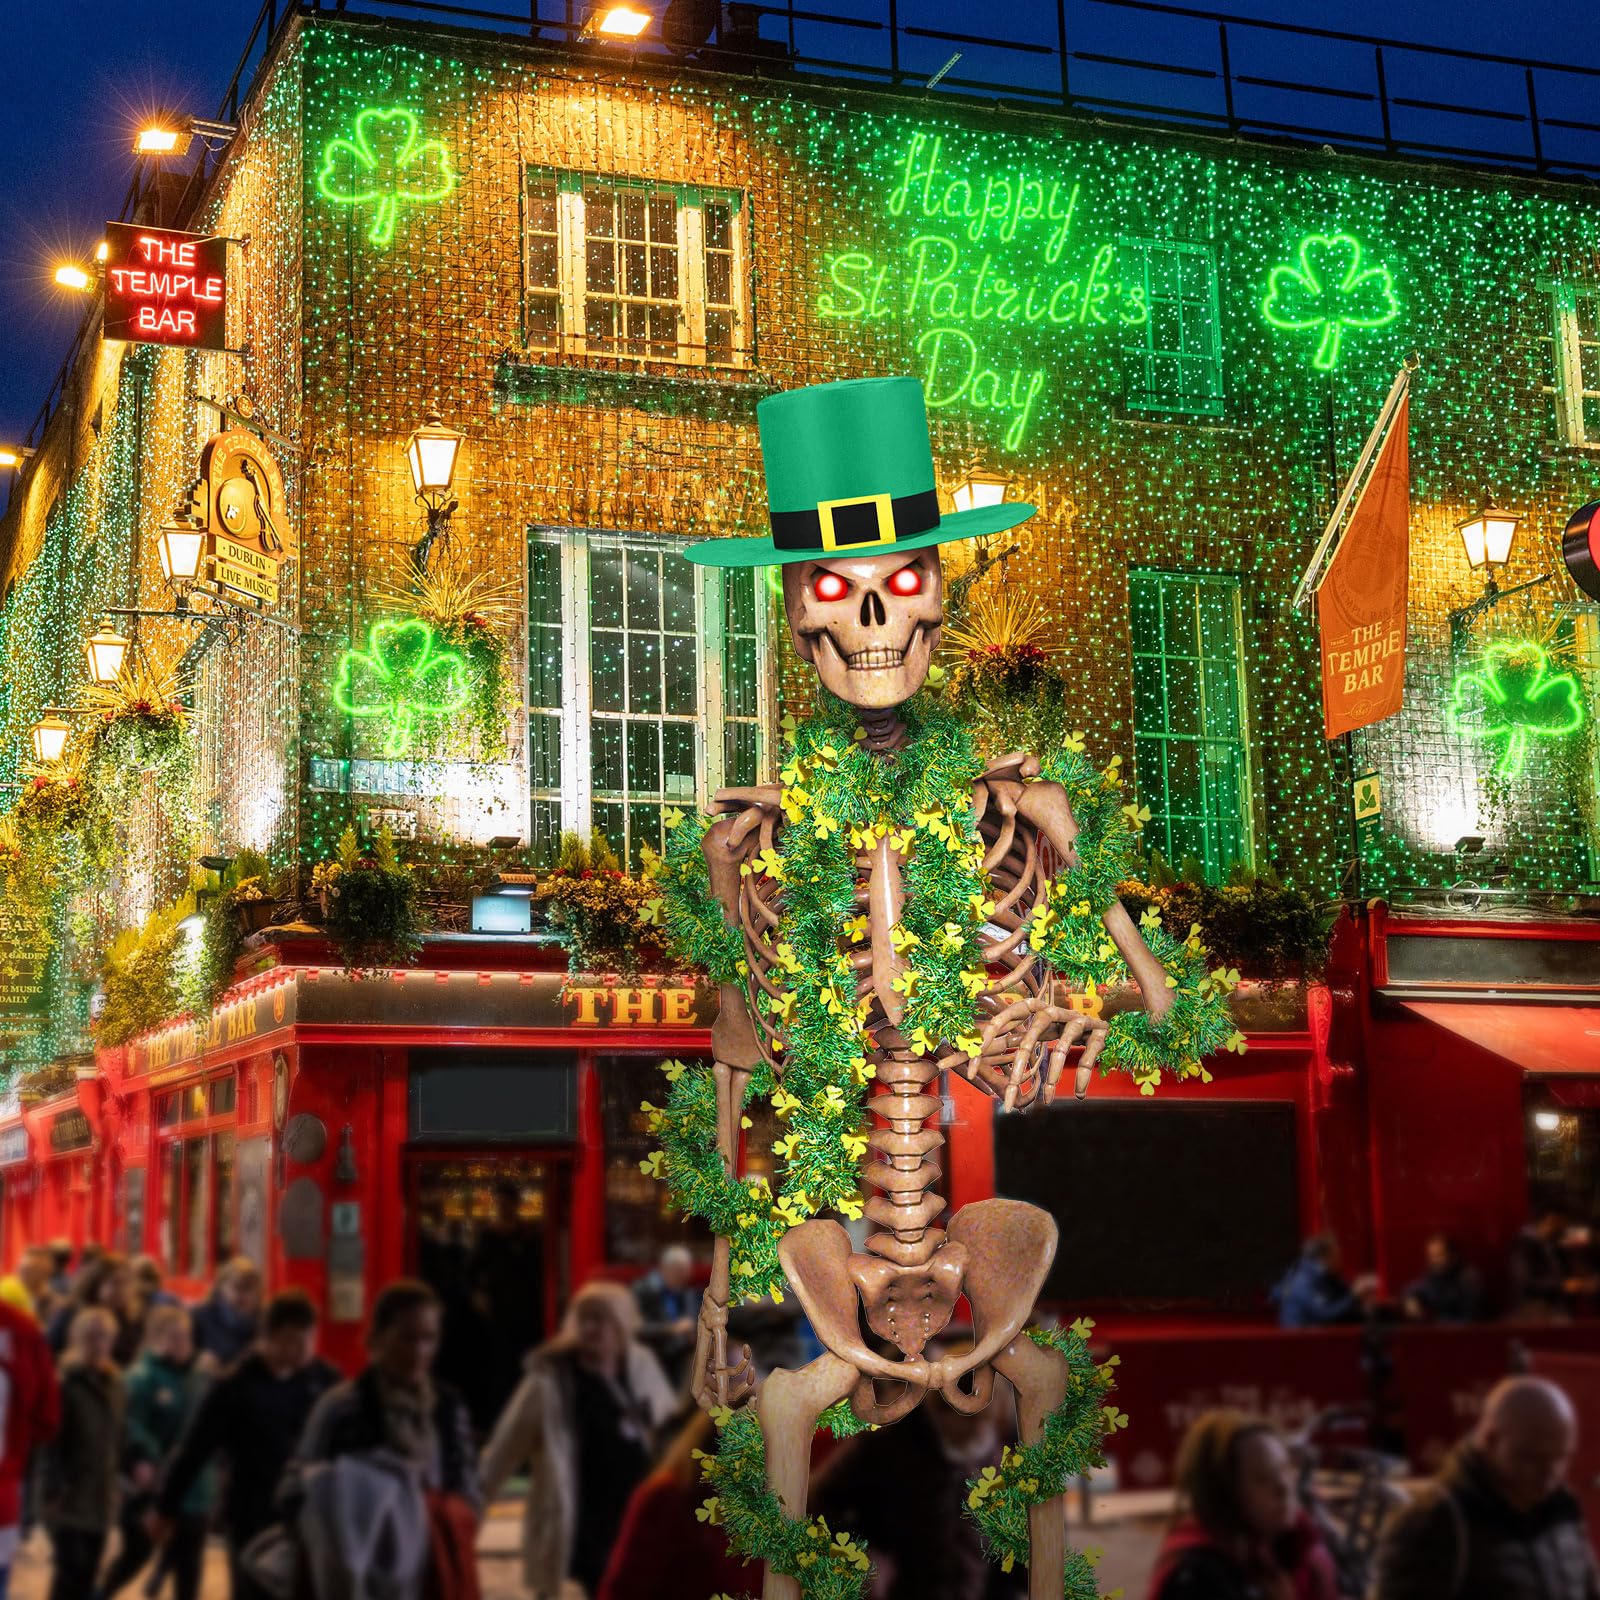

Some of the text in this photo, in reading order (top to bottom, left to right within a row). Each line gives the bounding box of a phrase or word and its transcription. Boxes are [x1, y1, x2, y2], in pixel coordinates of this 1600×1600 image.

[889, 132, 1080, 264] Happy
[140, 236, 196, 267] THE
[111, 269, 222, 301] TEMPLE
[907, 235, 1149, 324] Patrick's
[139, 306, 195, 334] BAR
[916, 327, 1044, 451] Day
[212, 447, 227, 486] THE
[224, 434, 271, 470] TEMPLE
[228, 545, 266, 570] DUBLIN
[221, 567, 273, 597] LIVE MUSIC
[1352, 621, 1382, 645] THE
[1327, 630, 1401, 676] TEMPLE
[1343, 665, 1384, 694] BAR
[10, 985, 44, 993] MUSIC
[565, 988, 698, 1025] THE
[148, 1035, 171, 1068] THE
[227, 1000, 257, 1041] BAR
